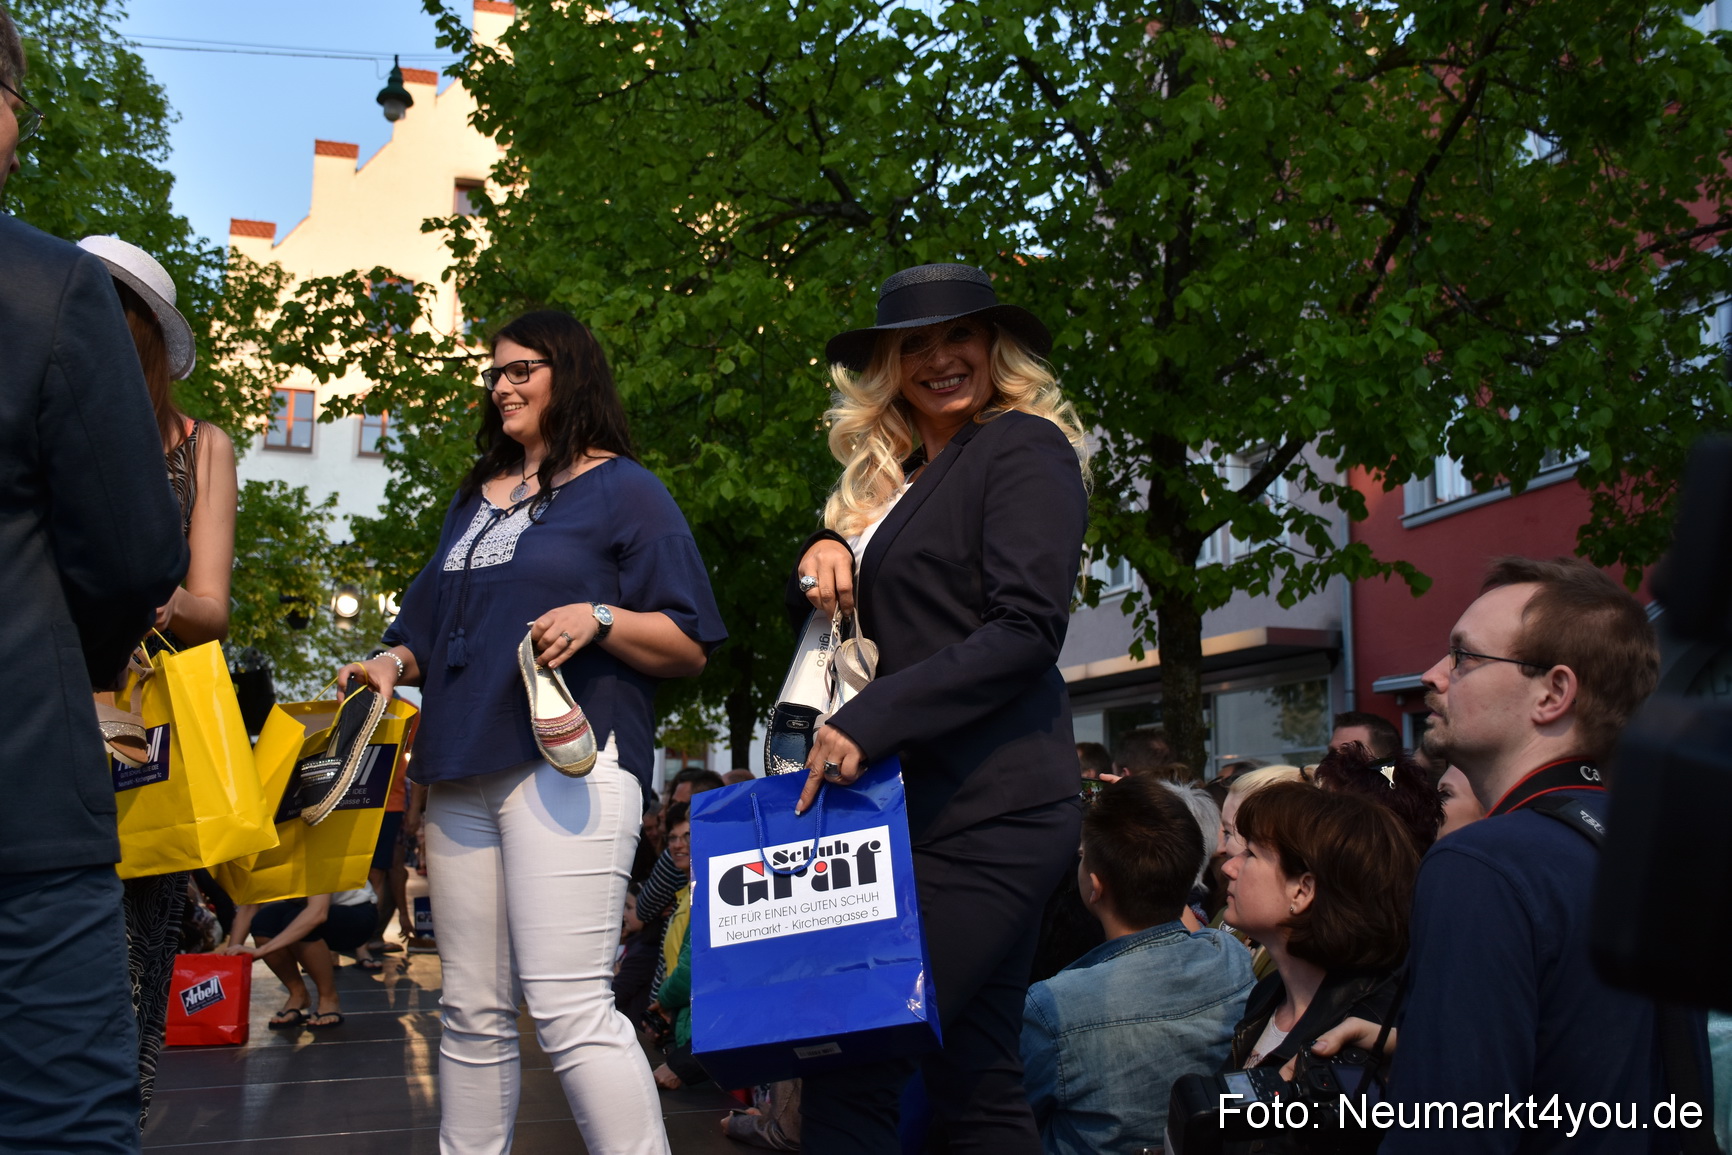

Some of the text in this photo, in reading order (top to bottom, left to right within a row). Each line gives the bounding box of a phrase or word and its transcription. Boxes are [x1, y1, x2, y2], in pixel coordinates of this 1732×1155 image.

[773, 840, 850, 866] Schuh
[718, 891, 880, 928] ZEIT FÜR EINEN GUTEN SCHUH
[726, 923, 781, 941] Neumarkt
[792, 910, 869, 930] Kirchengasse
[872, 906, 879, 917] 5
[185, 978, 219, 1007] Arbell
